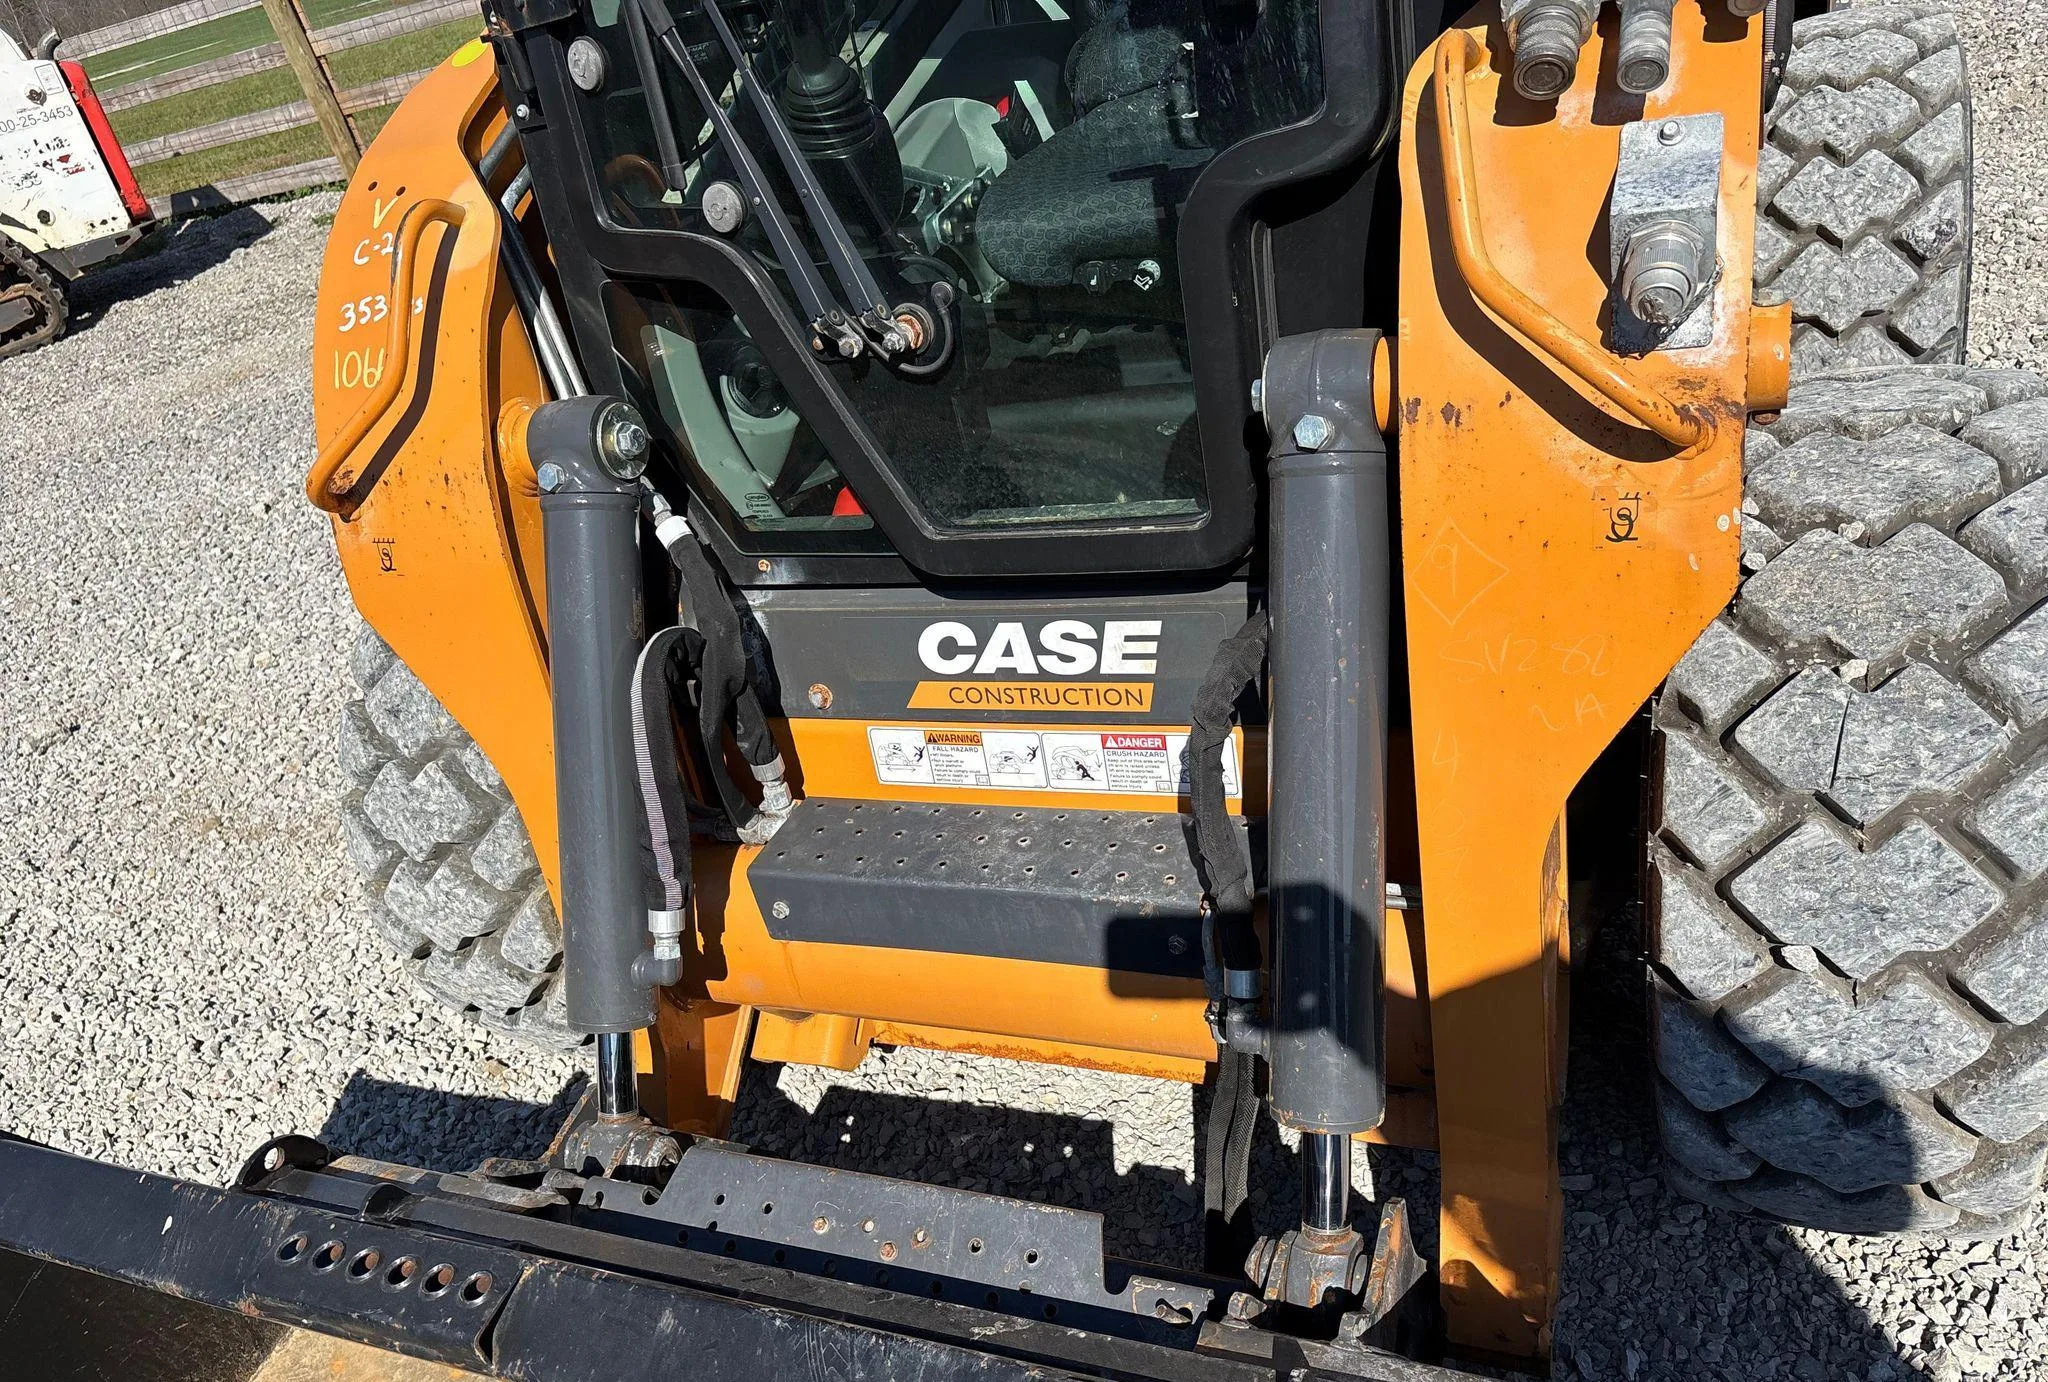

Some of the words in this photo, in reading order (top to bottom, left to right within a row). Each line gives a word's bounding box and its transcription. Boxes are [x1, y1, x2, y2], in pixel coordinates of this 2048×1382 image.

[917, 619, 1163, 676] CASE
[949, 686, 1144, 707] CONSTRUCTION
[935, 733, 981, 744] WARNING
[1117, 737, 1162, 749] DANGER
